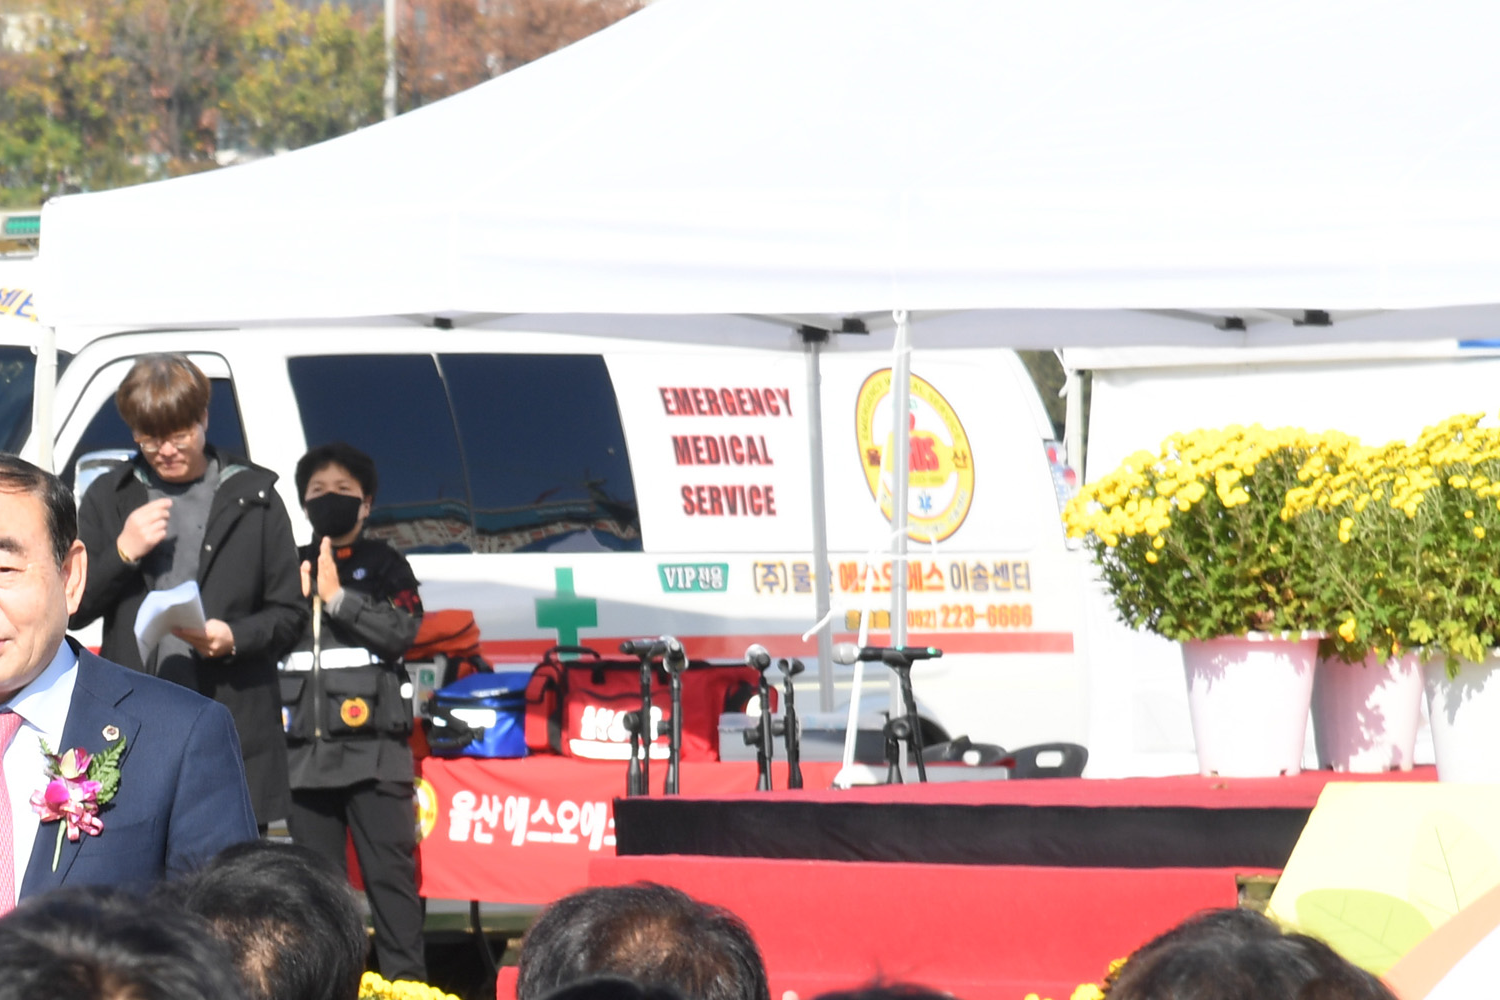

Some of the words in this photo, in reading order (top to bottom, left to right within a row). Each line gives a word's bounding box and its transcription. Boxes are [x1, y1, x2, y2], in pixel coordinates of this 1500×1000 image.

[658, 387, 793, 416] EMERGENCY
[670, 435, 773, 465] MEDICAL
[681, 485, 777, 516] SERVICE
[950, 562, 1031, 591] 이송센터
[941, 604, 1033, 628] 223-6666
